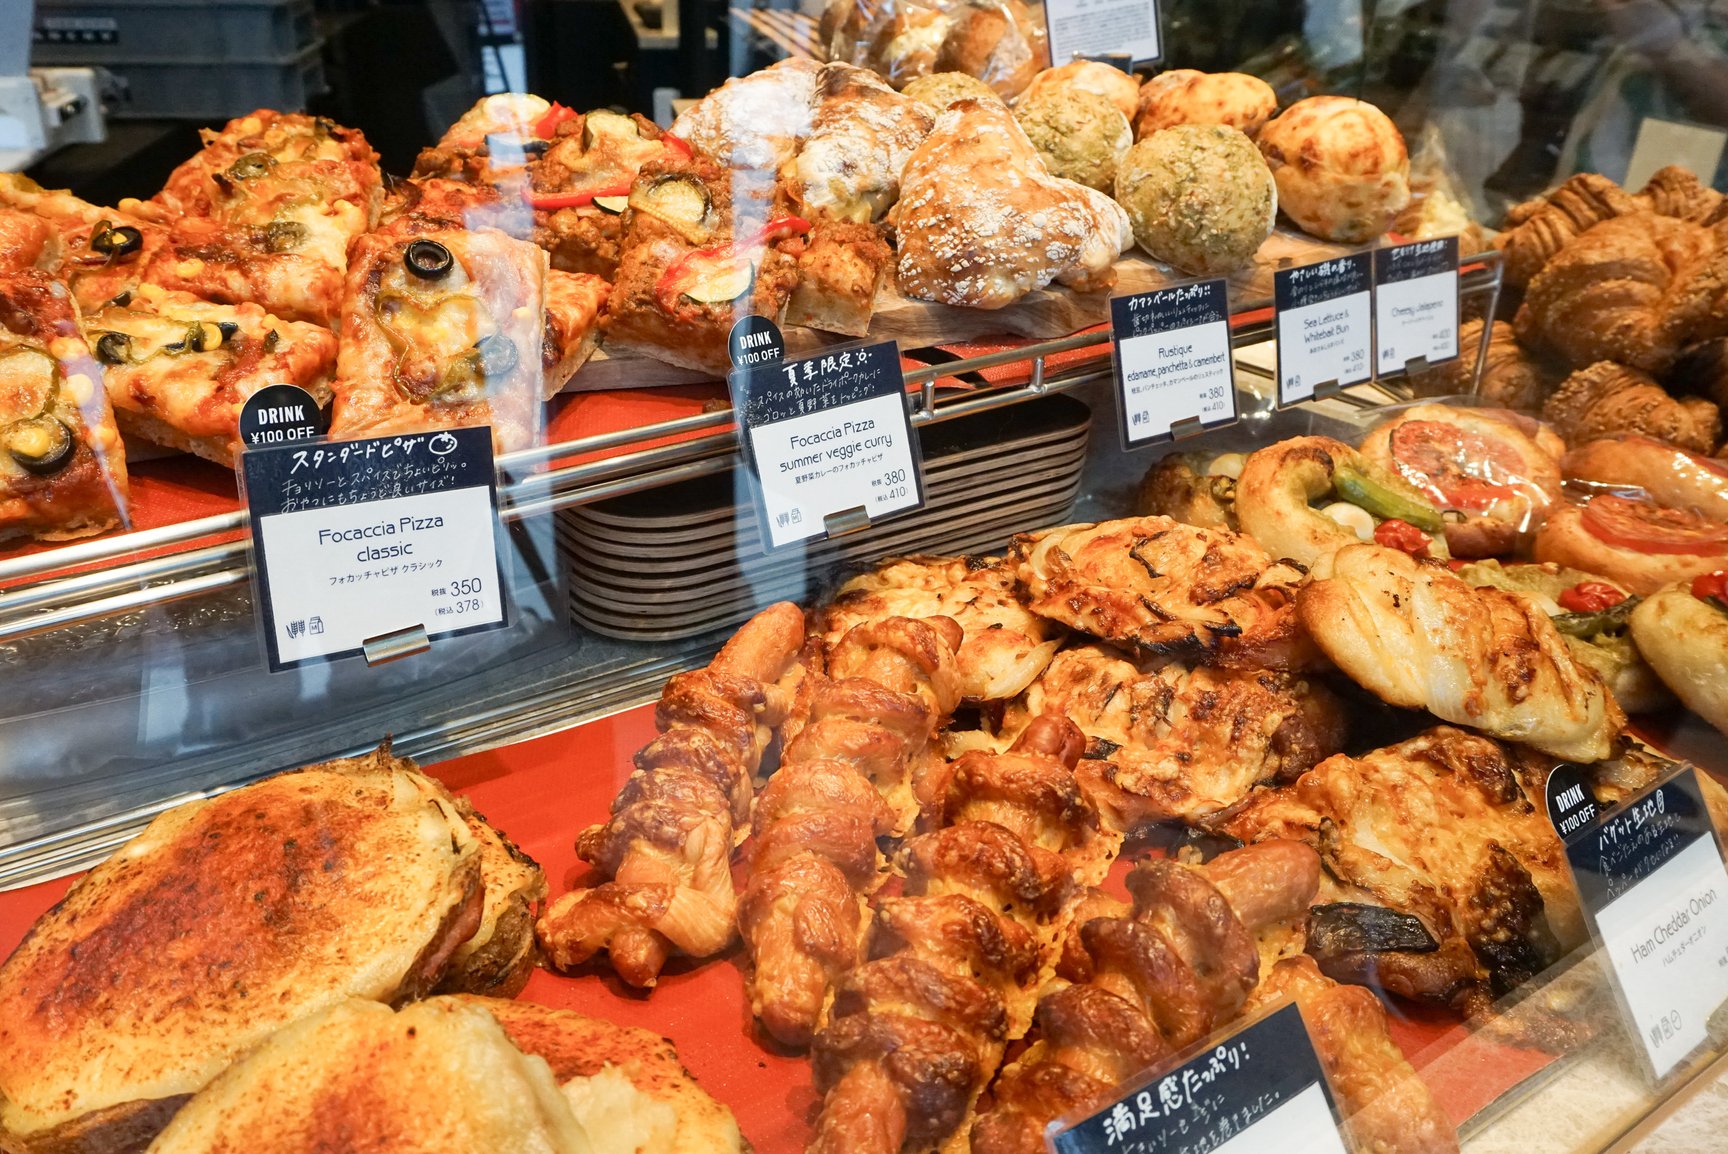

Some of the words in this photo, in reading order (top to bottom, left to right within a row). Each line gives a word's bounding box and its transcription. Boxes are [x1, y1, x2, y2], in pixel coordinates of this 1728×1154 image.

[1319, 311, 1344, 327] Lettuce
[1335, 323, 1349, 335] Bun
[740, 331, 772, 350] DRINK
[737, 353, 760, 367] ¥100
[761, 347, 780, 359] OFF
[1158, 343, 1193, 360] Rustique
[1193, 352, 1226, 368] camembert
[782, 351, 853, 387] 夏季限定
[1208, 386, 1225, 400] 380
[257, 405, 305, 425] DRINK
[250, 430, 284, 445] ¥100
[287, 426, 315, 441] OFF
[790, 425, 843, 450] Focaccia
[844, 417, 875, 436] Pizza
[289, 436, 425, 475] スタンダードピザ
[779, 452, 823, 474] summer
[827, 441, 863, 460] veggie
[864, 433, 893, 449] curry
[884, 468, 906, 486] 380
[318, 521, 396, 545] Focaccia
[399, 514, 445, 533] Pizza
[356, 542, 414, 563] classic
[450, 577, 482, 597] 350
[1555, 783, 1586, 813] DRINK
[1559, 814, 1581, 835] ¥100
[1578, 803, 1596, 823] OFF
[1599, 801, 1656, 851] バゲット生地
[1630, 940, 1657, 964] Ham
[1653, 908, 1690, 946] Cheddar
[1689, 887, 1718, 917] Onion
[1102, 1042, 1251, 1146] 満足感たっぷり!
